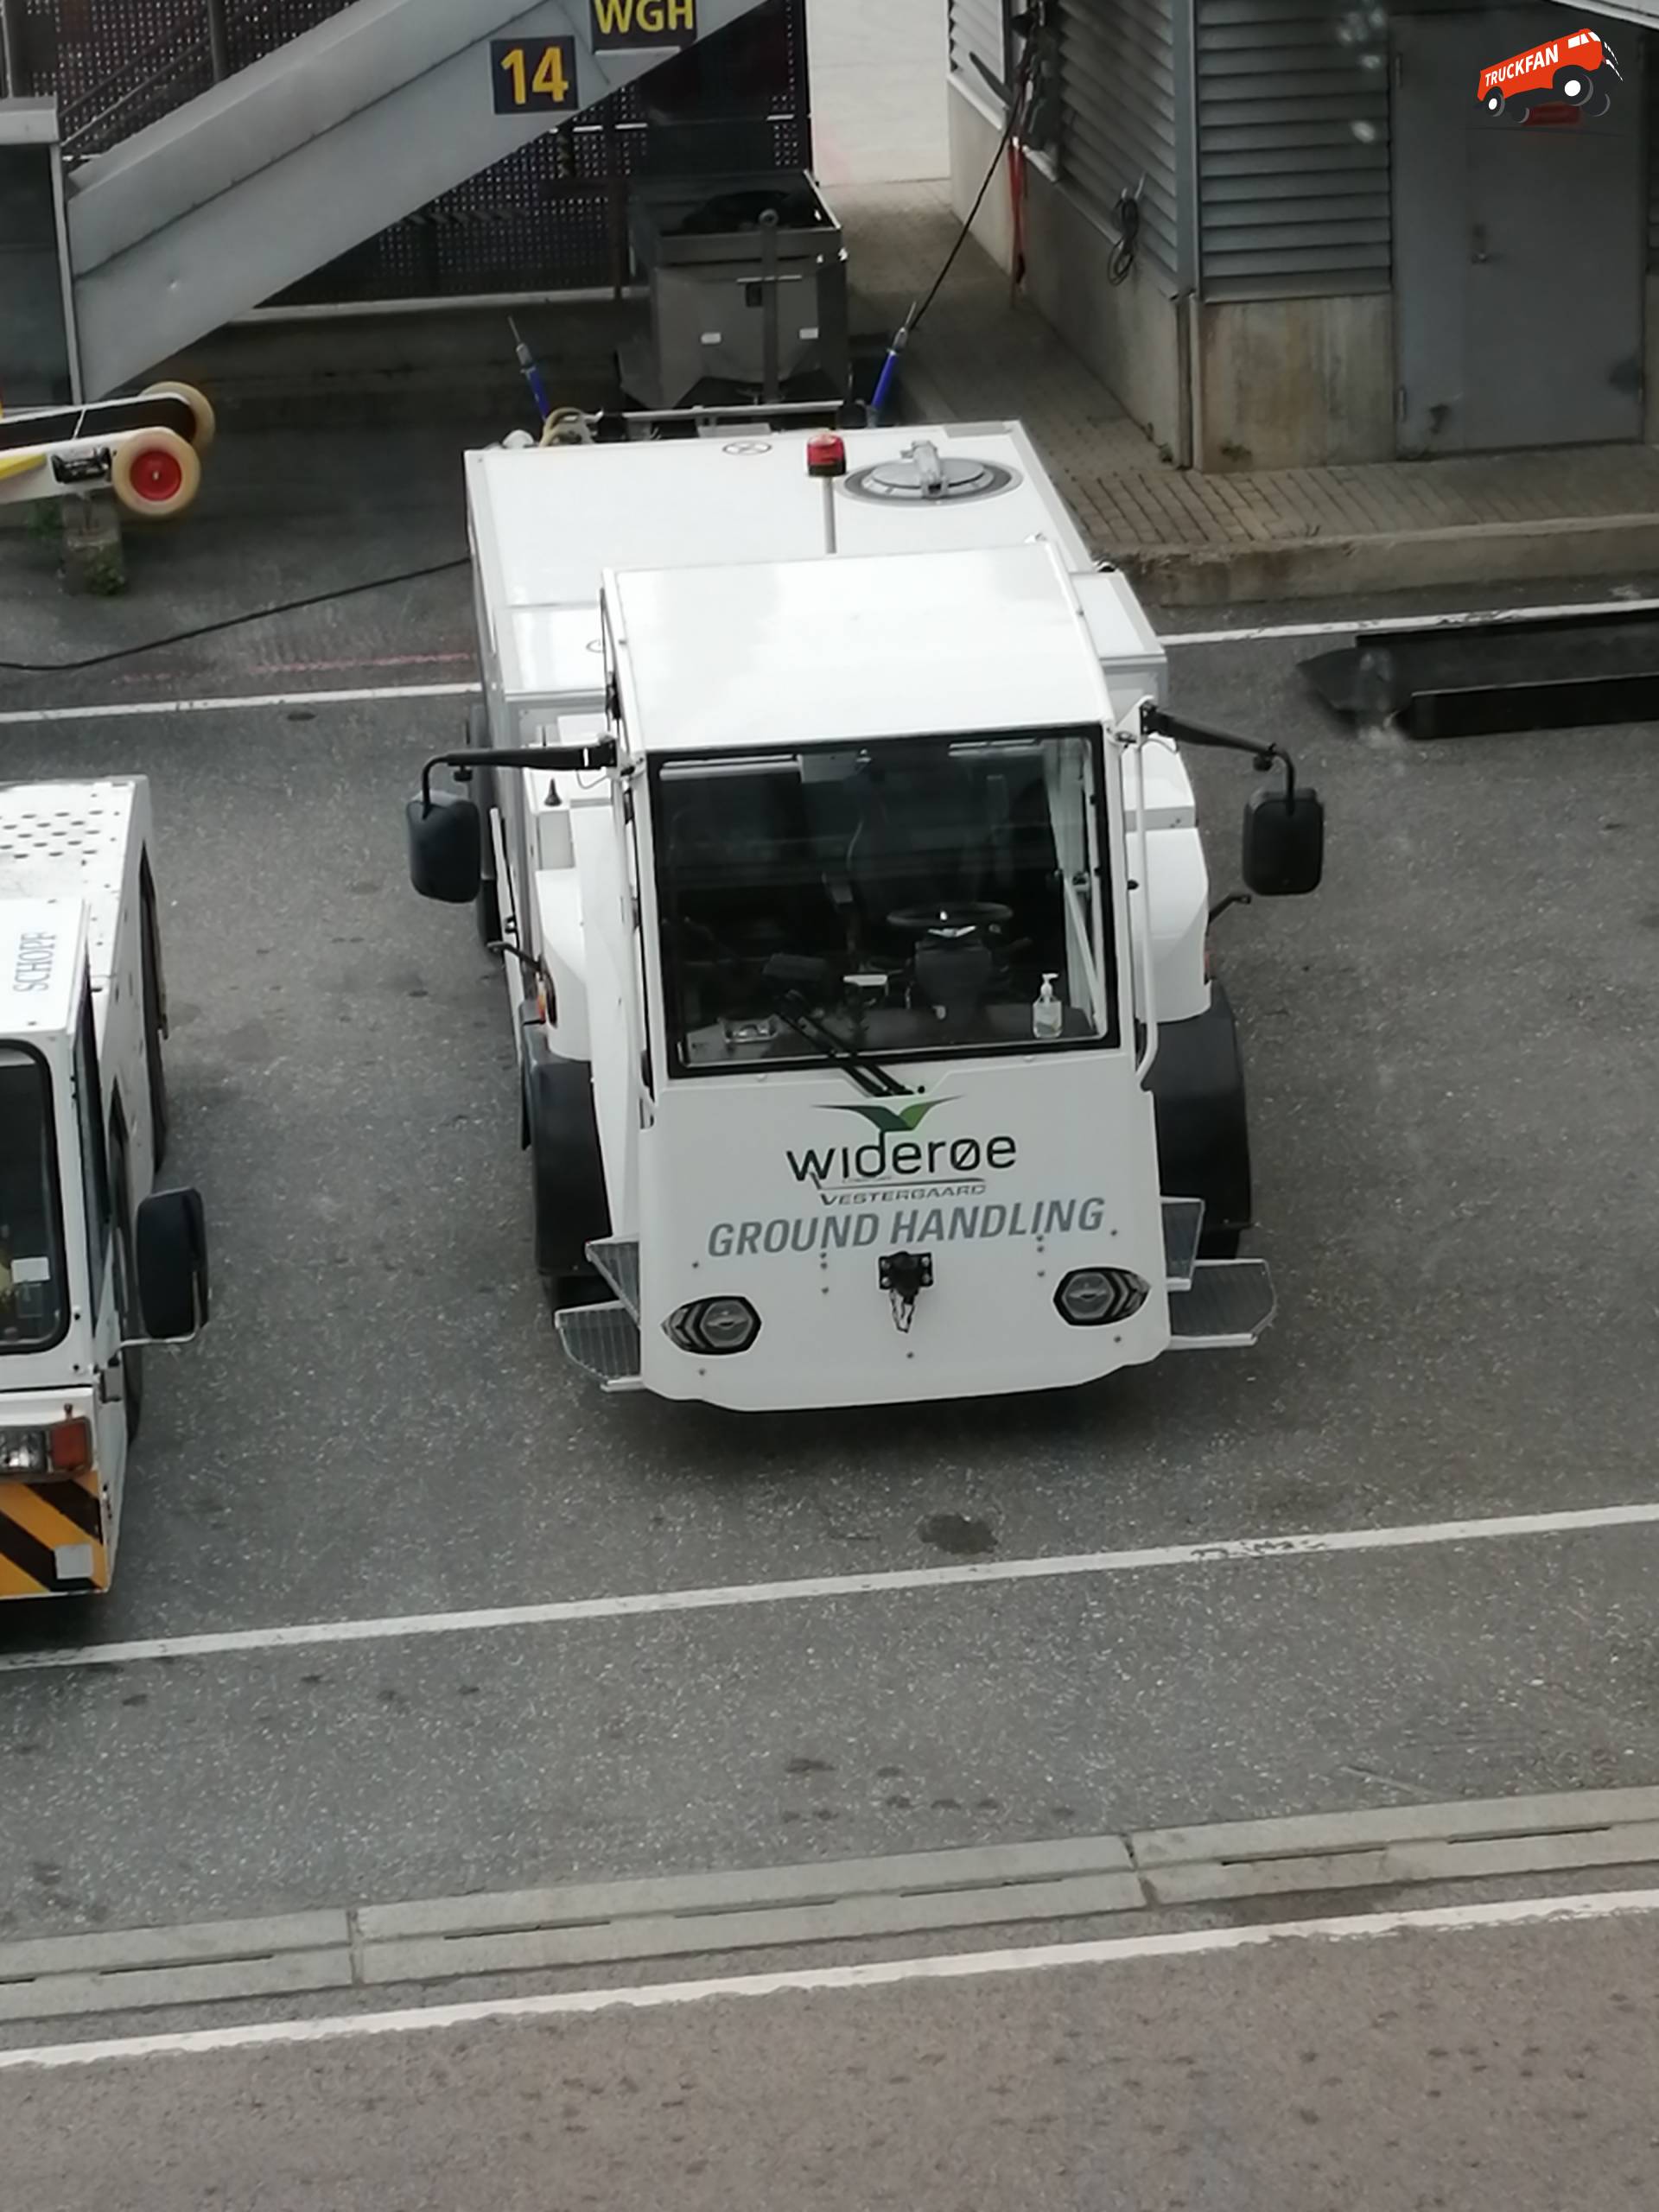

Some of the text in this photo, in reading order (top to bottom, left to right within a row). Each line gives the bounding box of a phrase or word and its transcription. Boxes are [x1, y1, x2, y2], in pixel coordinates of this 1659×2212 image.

[594, 0, 694, 34] WGH
[500, 47, 569, 105] 14
[13, 932, 57, 992] SCHOPF
[820, 1185, 987, 1206] VESTERGAARD
[708, 1197, 1105, 1257] GROUND HANDLING
